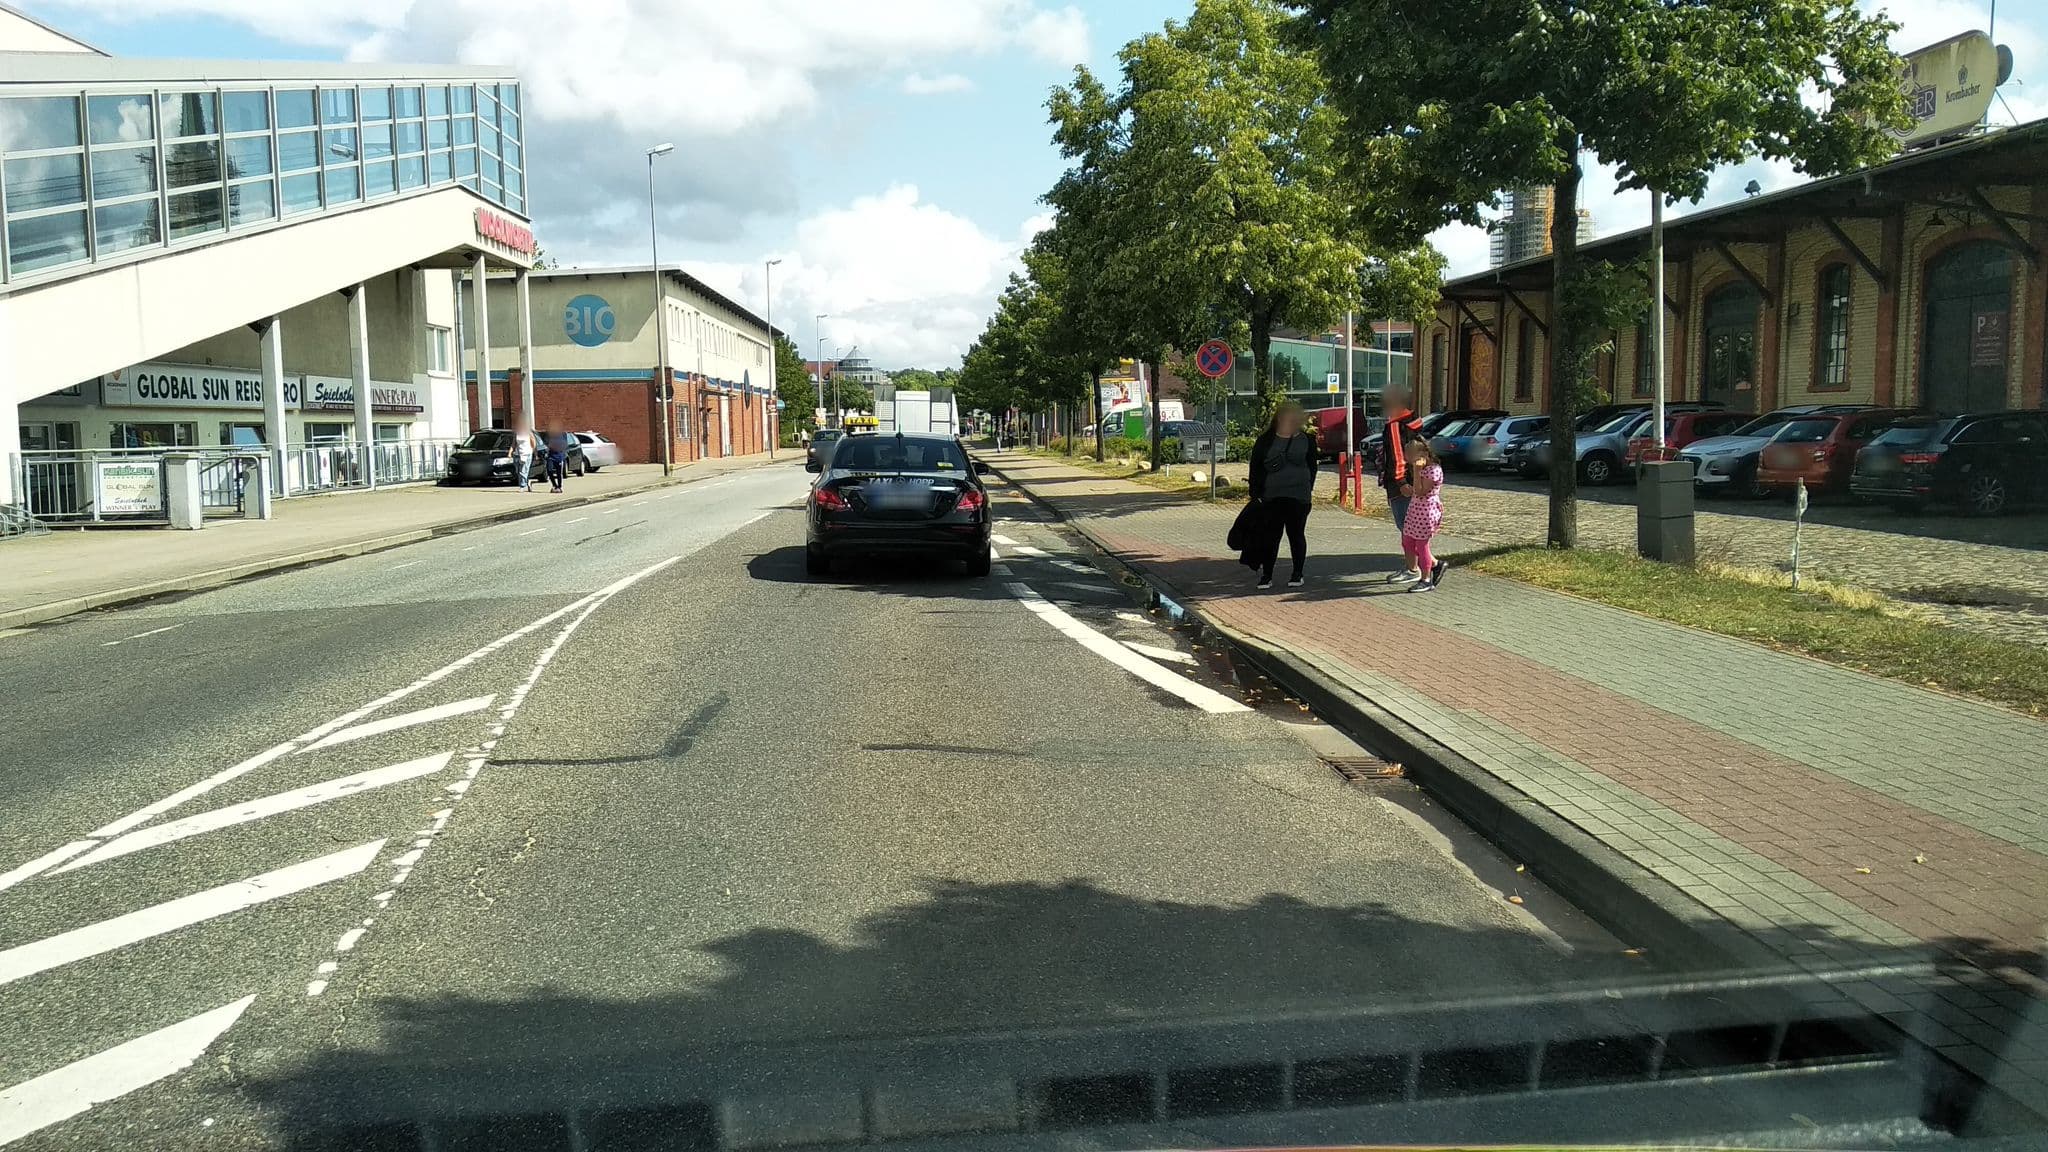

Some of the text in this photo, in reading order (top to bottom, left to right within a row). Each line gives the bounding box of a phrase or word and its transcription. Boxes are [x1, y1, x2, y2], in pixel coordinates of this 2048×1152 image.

[1945, 84, 1980, 103] Krombacher
[563, 305, 617, 337] BIO
[1977, 316, 1986, 334] P
[137, 374, 298, 403] GLOBAL SUN REISRO
[401, 390, 417, 405] PLAY
[850, 416, 874, 425] TAXI
[869, 477, 893, 485] TAXI
